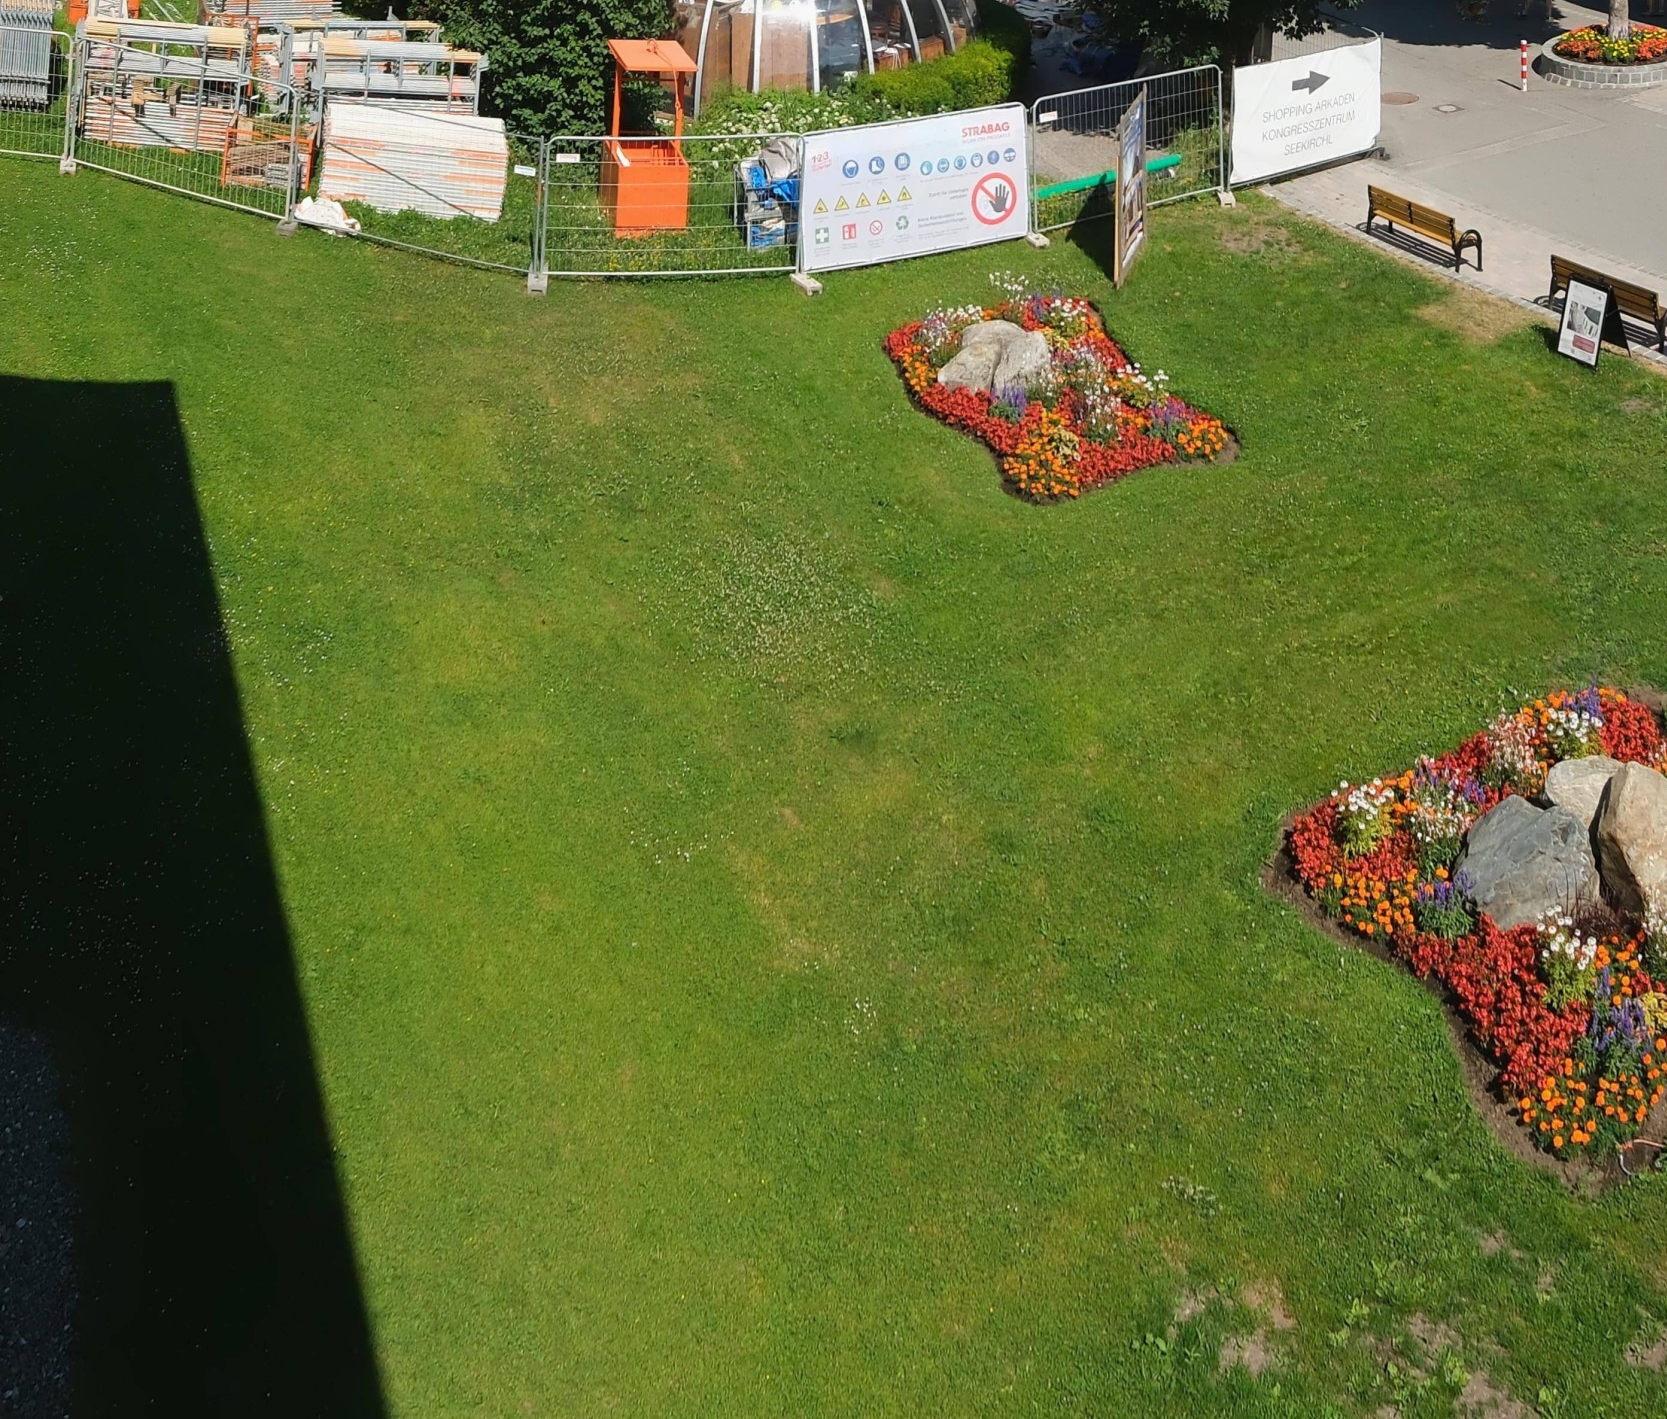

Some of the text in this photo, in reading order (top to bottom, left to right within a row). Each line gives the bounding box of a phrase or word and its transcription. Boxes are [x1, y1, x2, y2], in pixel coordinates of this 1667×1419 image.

[1262, 93, 1355, 124] SHOPPING ARKADEN
[961, 121, 1010, 138] STRABAG
[1262, 110, 1356, 142] KONGRESSZENTRUM
[1284, 134, 1334, 156] SEEKIRCHL
